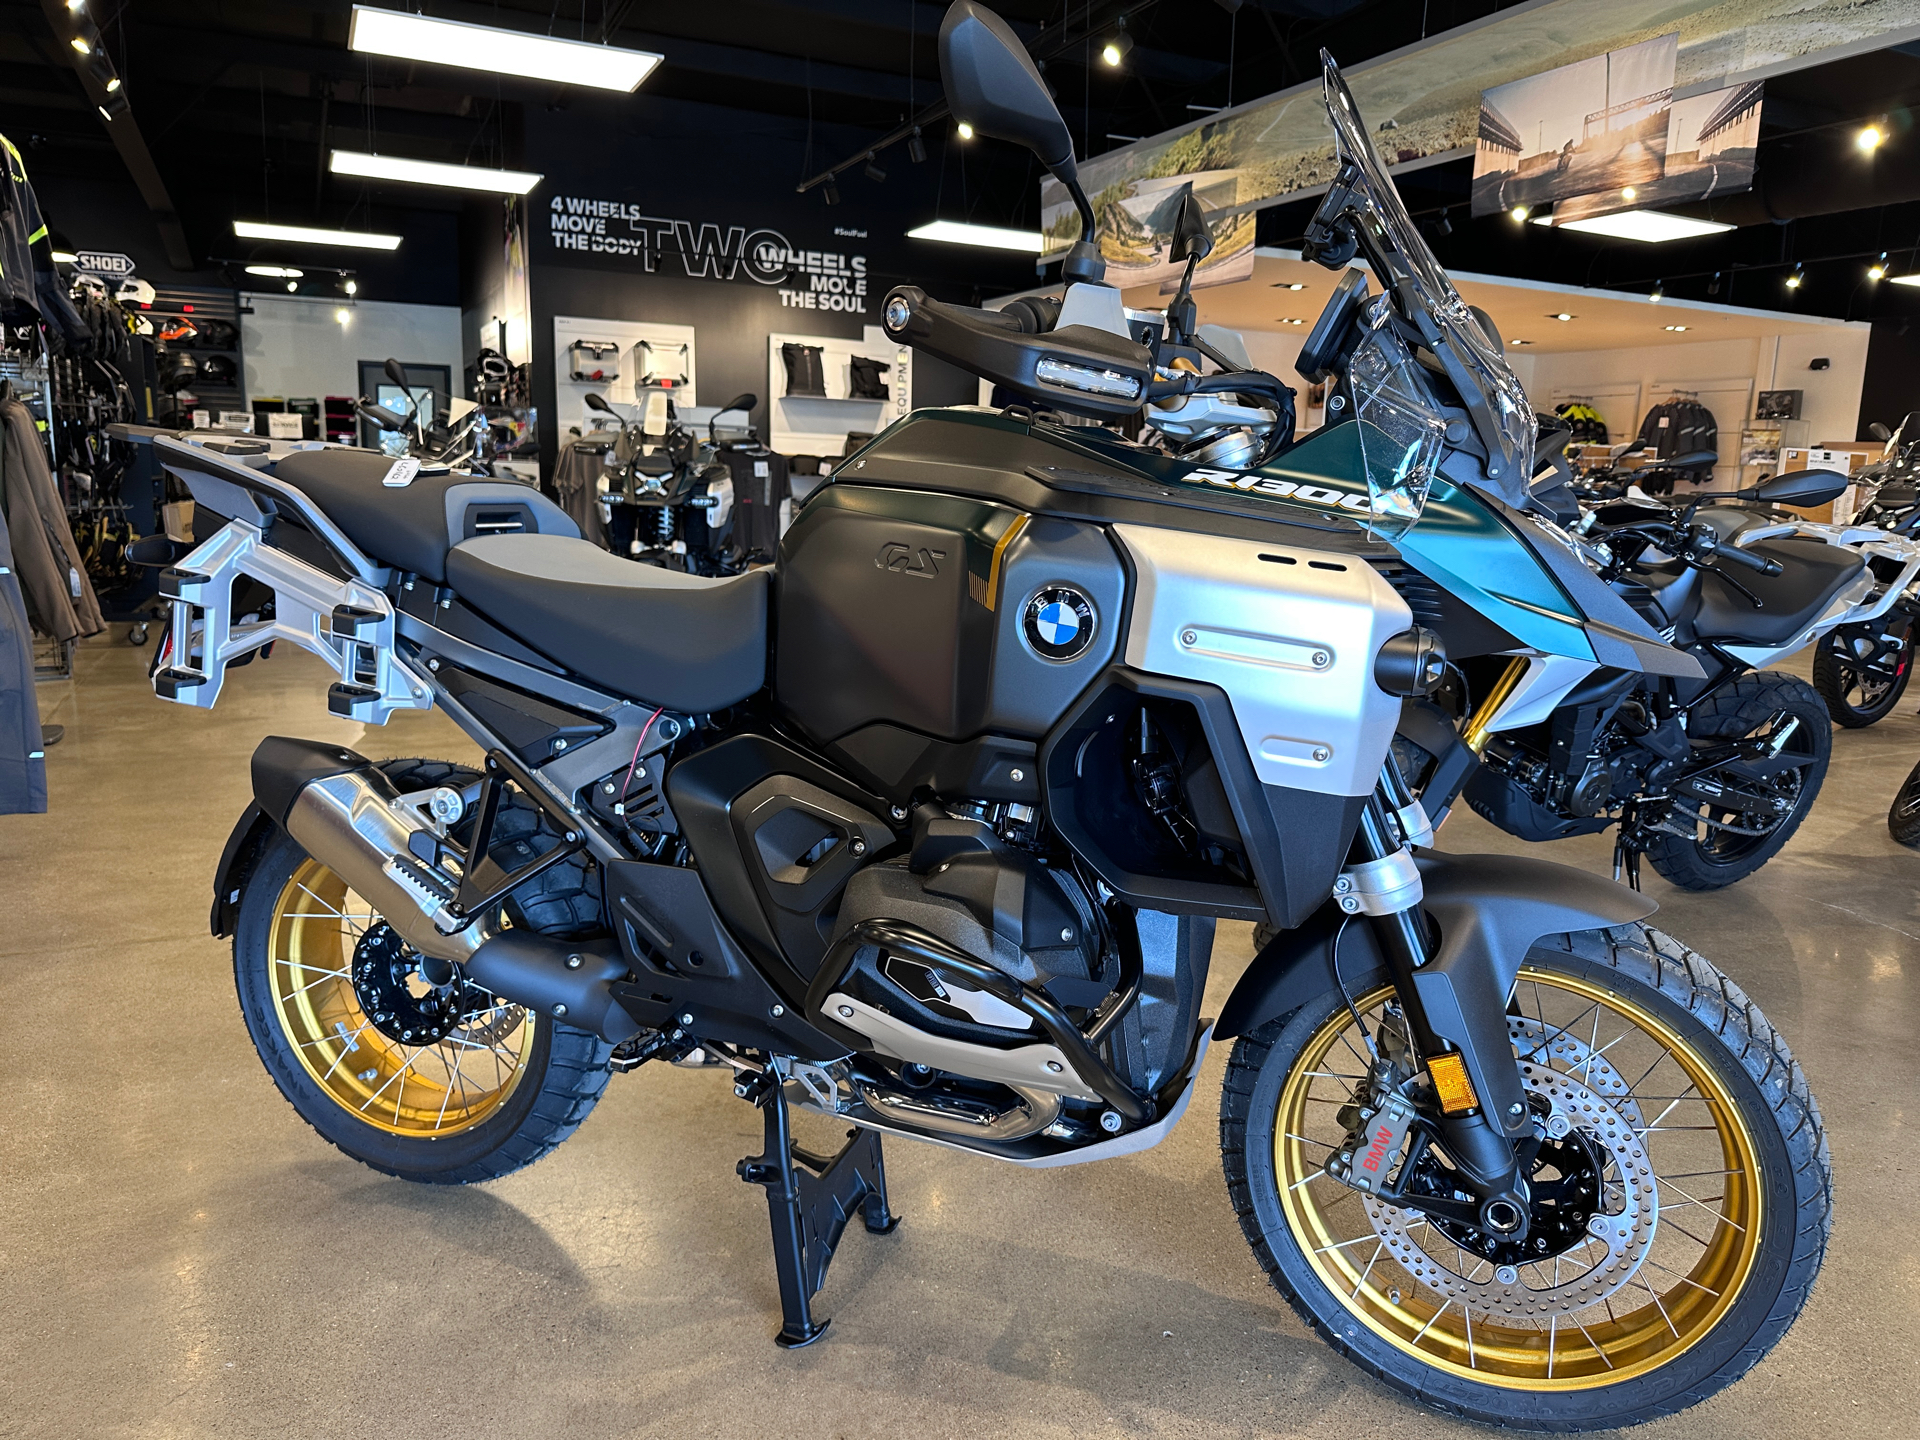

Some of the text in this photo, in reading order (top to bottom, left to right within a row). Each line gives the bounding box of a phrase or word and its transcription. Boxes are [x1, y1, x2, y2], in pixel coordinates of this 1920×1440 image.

[551, 196, 640, 221] 4 WHEELS
[551, 213, 606, 235] MOVE
[552, 231, 642, 256] THE BODY
[80, 255, 127, 272] SHOEI
[758, 246, 867, 278] WHEELS
[778, 289, 867, 314] THE SOUL
[896, 345, 908, 416] EQUIPMEN
[875, 541, 947, 579] GS
[1034, 590, 1091, 619] BMW
[252, 1006, 310, 1099] ANAKEE
[1362, 1125, 1394, 1173] BMW
